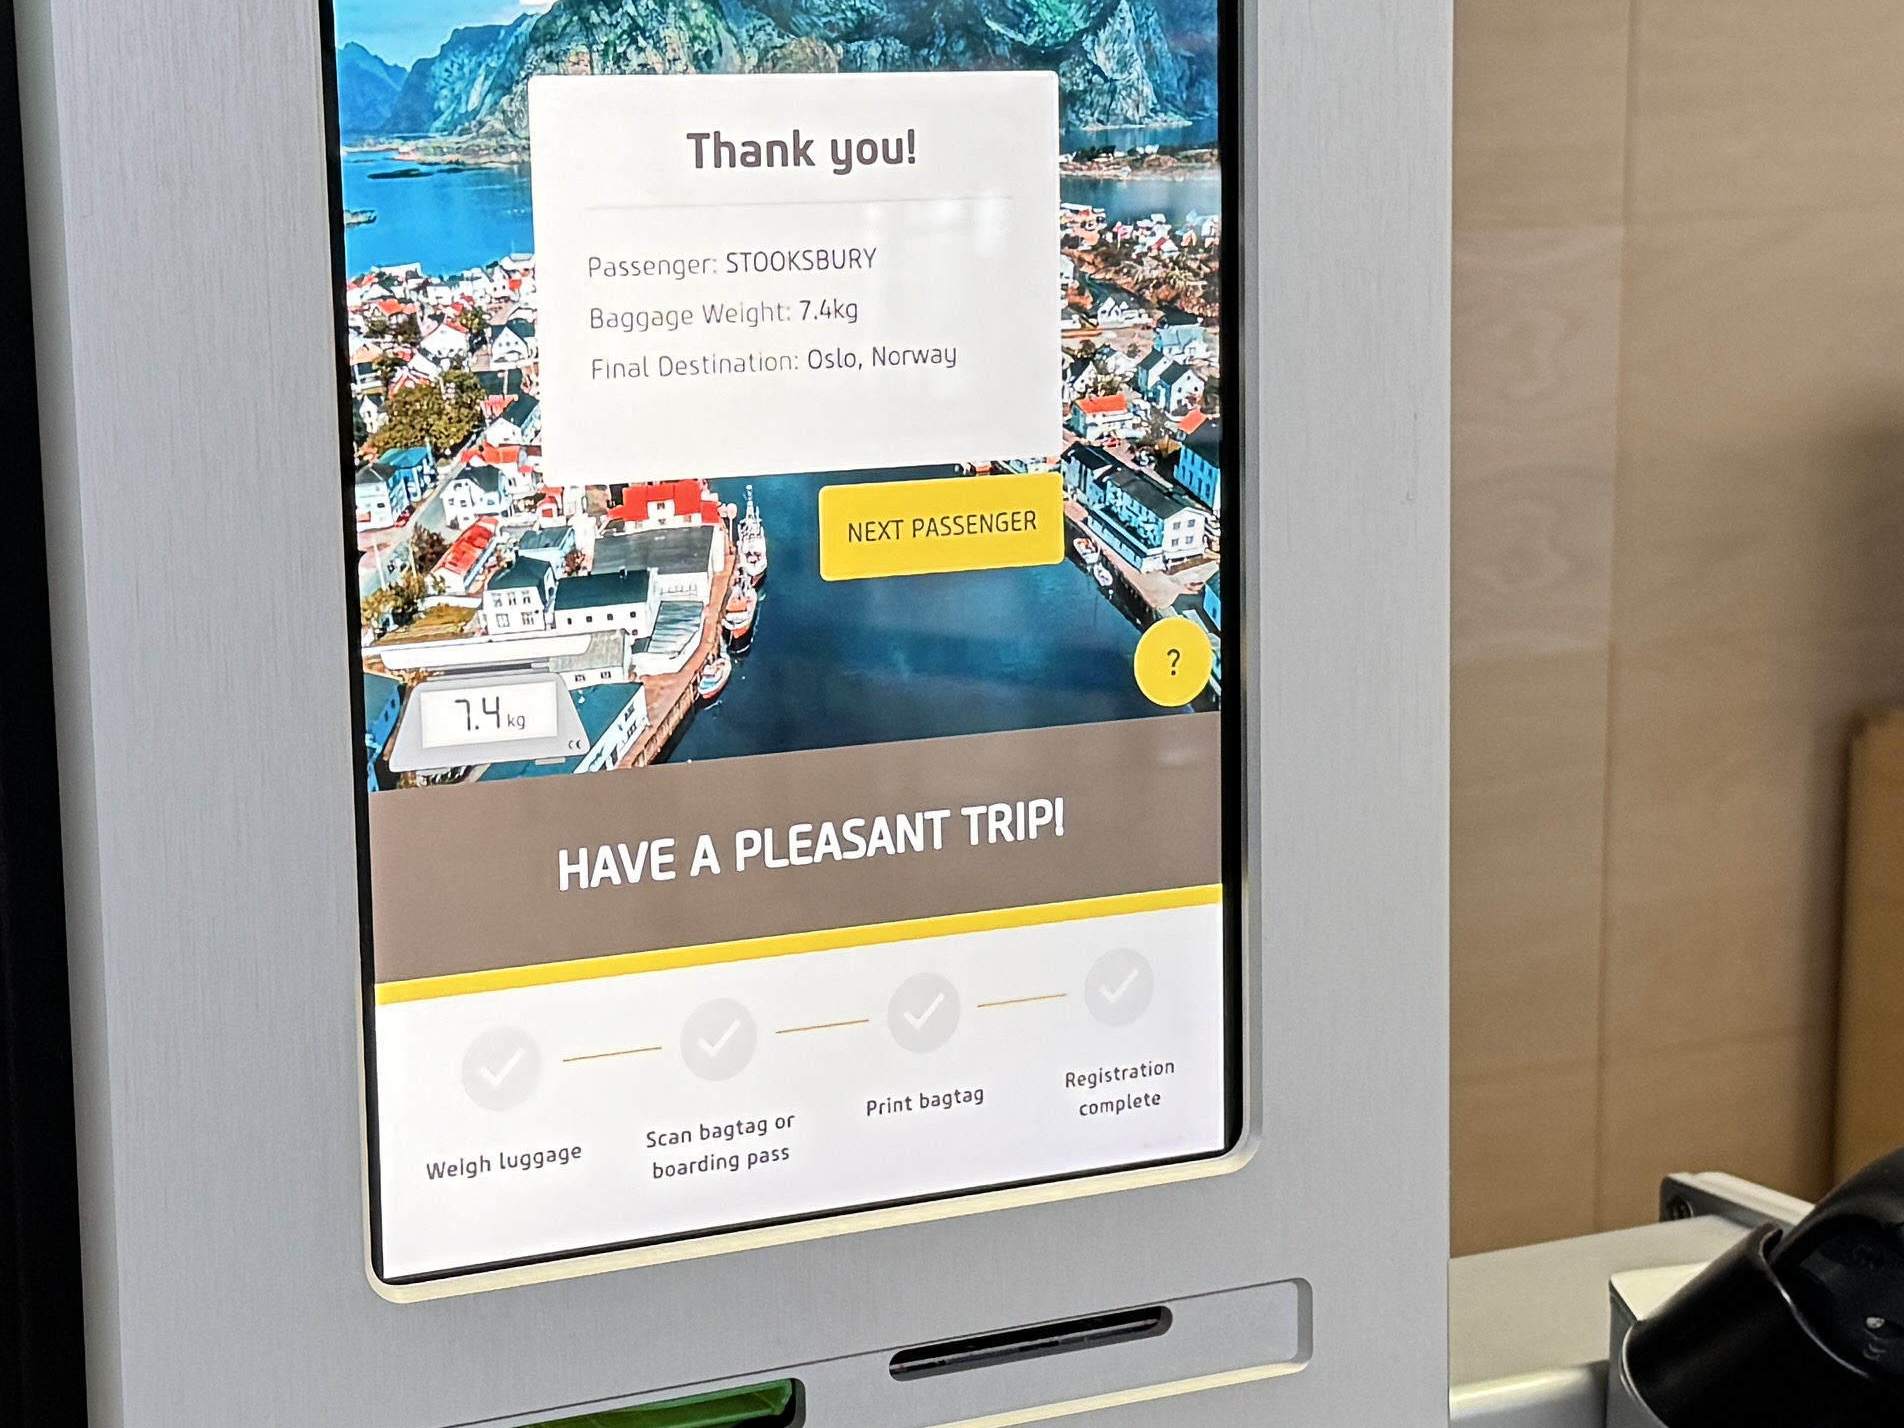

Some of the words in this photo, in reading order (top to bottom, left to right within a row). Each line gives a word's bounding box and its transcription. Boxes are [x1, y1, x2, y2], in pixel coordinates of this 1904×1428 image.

[686, 130, 816, 170] Thank
[831, 129, 916, 175] you!
[588, 255, 717, 281] Passenger:
[726, 248, 877, 274] STOOKSBURY
[590, 306, 693, 331] Baggage
[703, 302, 791, 325] Weight:
[799, 298, 859, 324] 7.4kg
[592, 356, 648, 380] Final
[659, 352, 798, 376] Destination:
[808, 348, 863, 371] Oslo,
[872, 345, 957, 368] Norway
[847, 517, 905, 543] NEXT
[912, 510, 1038, 539] PASSENGER
[455, 696, 500, 731] 7.4
[507, 714, 526, 730] kg
[558, 837, 676, 892] HAVE
[690, 835, 723, 875] A
[735, 809, 952, 873] PLEASANT
[960, 799, 1066, 845] TRIP!
[1064, 1058, 1176, 1091] Registration
[866, 1094, 912, 1116] Print
[919, 1084, 985, 1112] bagtag
[1079, 1092, 1161, 1119] complete
[646, 1125, 693, 1149] Scan
[698, 1116, 768, 1145] bagtag
[774, 1113, 796, 1133] or
[426, 1152, 491, 1181] Weigh
[499, 1141, 583, 1173] luggage
[652, 1151, 739, 1179] boarding
[747, 1145, 791, 1171] pass
